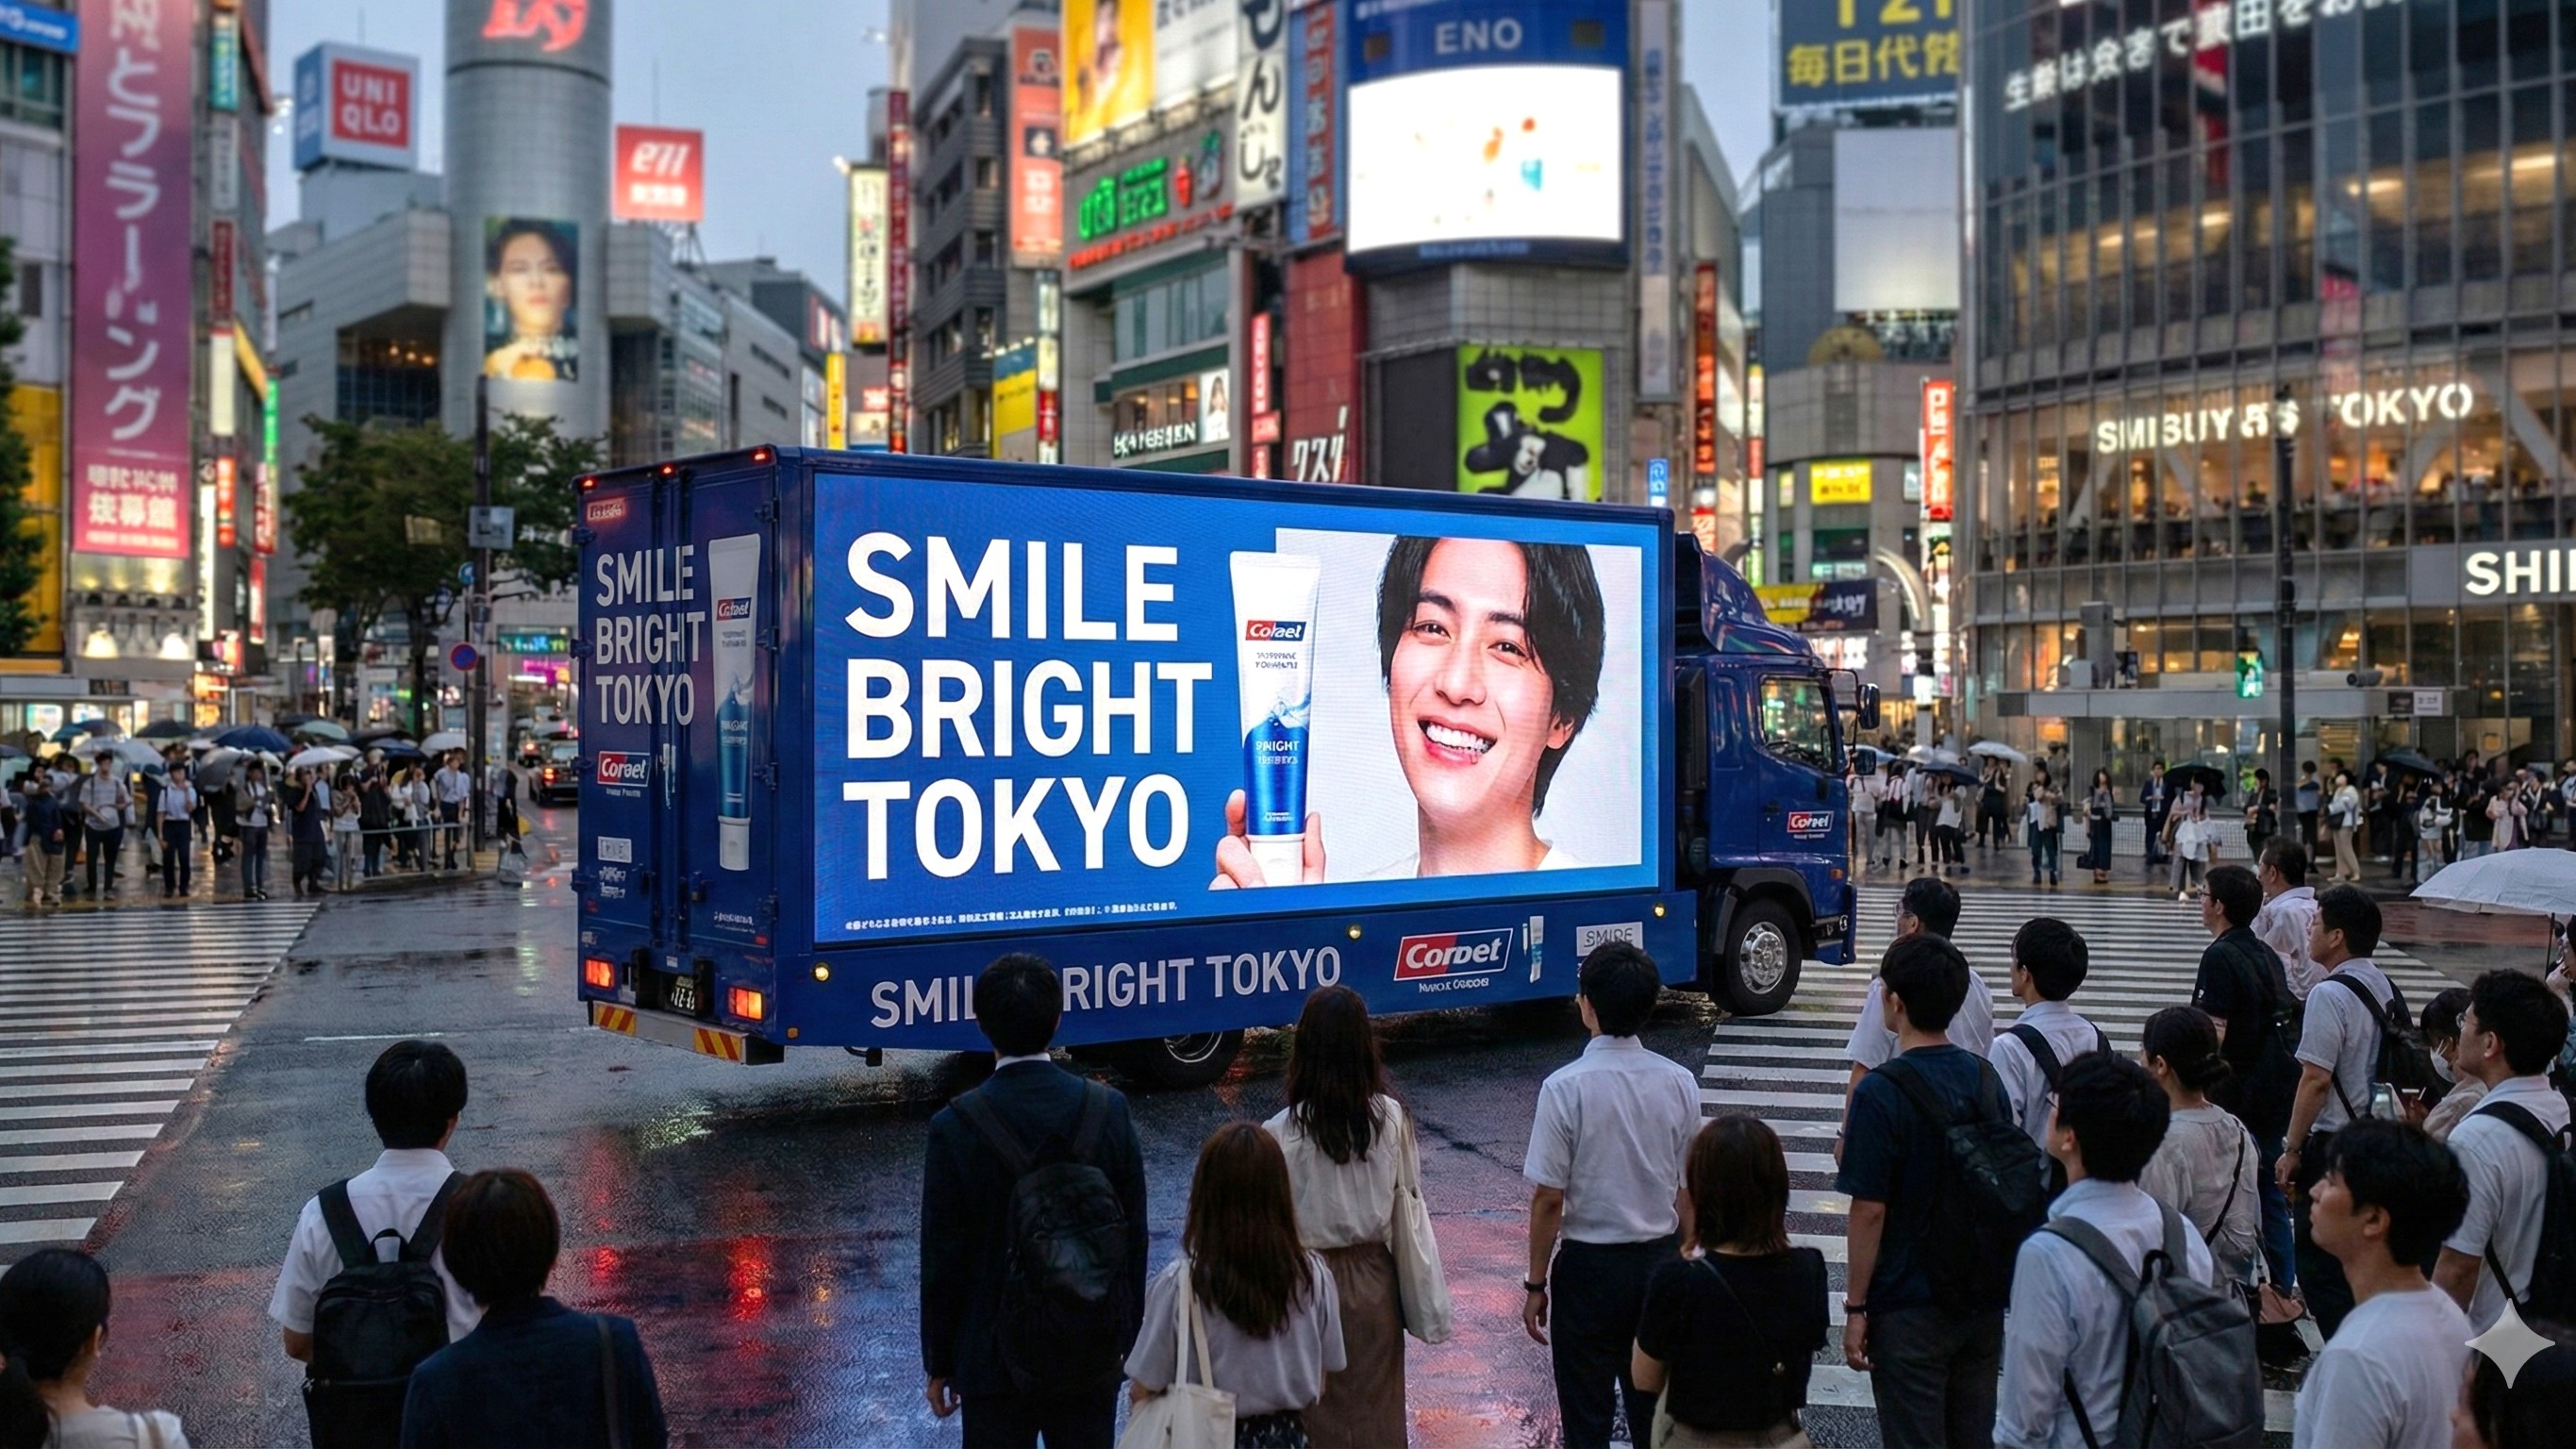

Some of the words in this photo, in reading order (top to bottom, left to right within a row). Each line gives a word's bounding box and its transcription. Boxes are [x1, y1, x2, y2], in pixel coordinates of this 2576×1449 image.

[1435, 17, 1523, 55] ENO
[341, 72, 397, 106] UNI
[341, 103, 401, 136] QLO
[2330, 383, 2473, 428] OKYO
[596, 544, 694, 607] SMILE
[844, 531, 1178, 641] SMILE
[2465, 549, 2576, 595] SHI
[596, 611, 706, 665] BRIGHT
[595, 673, 695, 726] TOKYO
[848, 658, 1213, 758] BRIGHT
[842, 773, 1189, 880] TOKYO
[870, 974, 977, 1028] SMIL
[1063, 957, 1194, 1012] RIGHT
[1206, 946, 1341, 998] TOKYO
